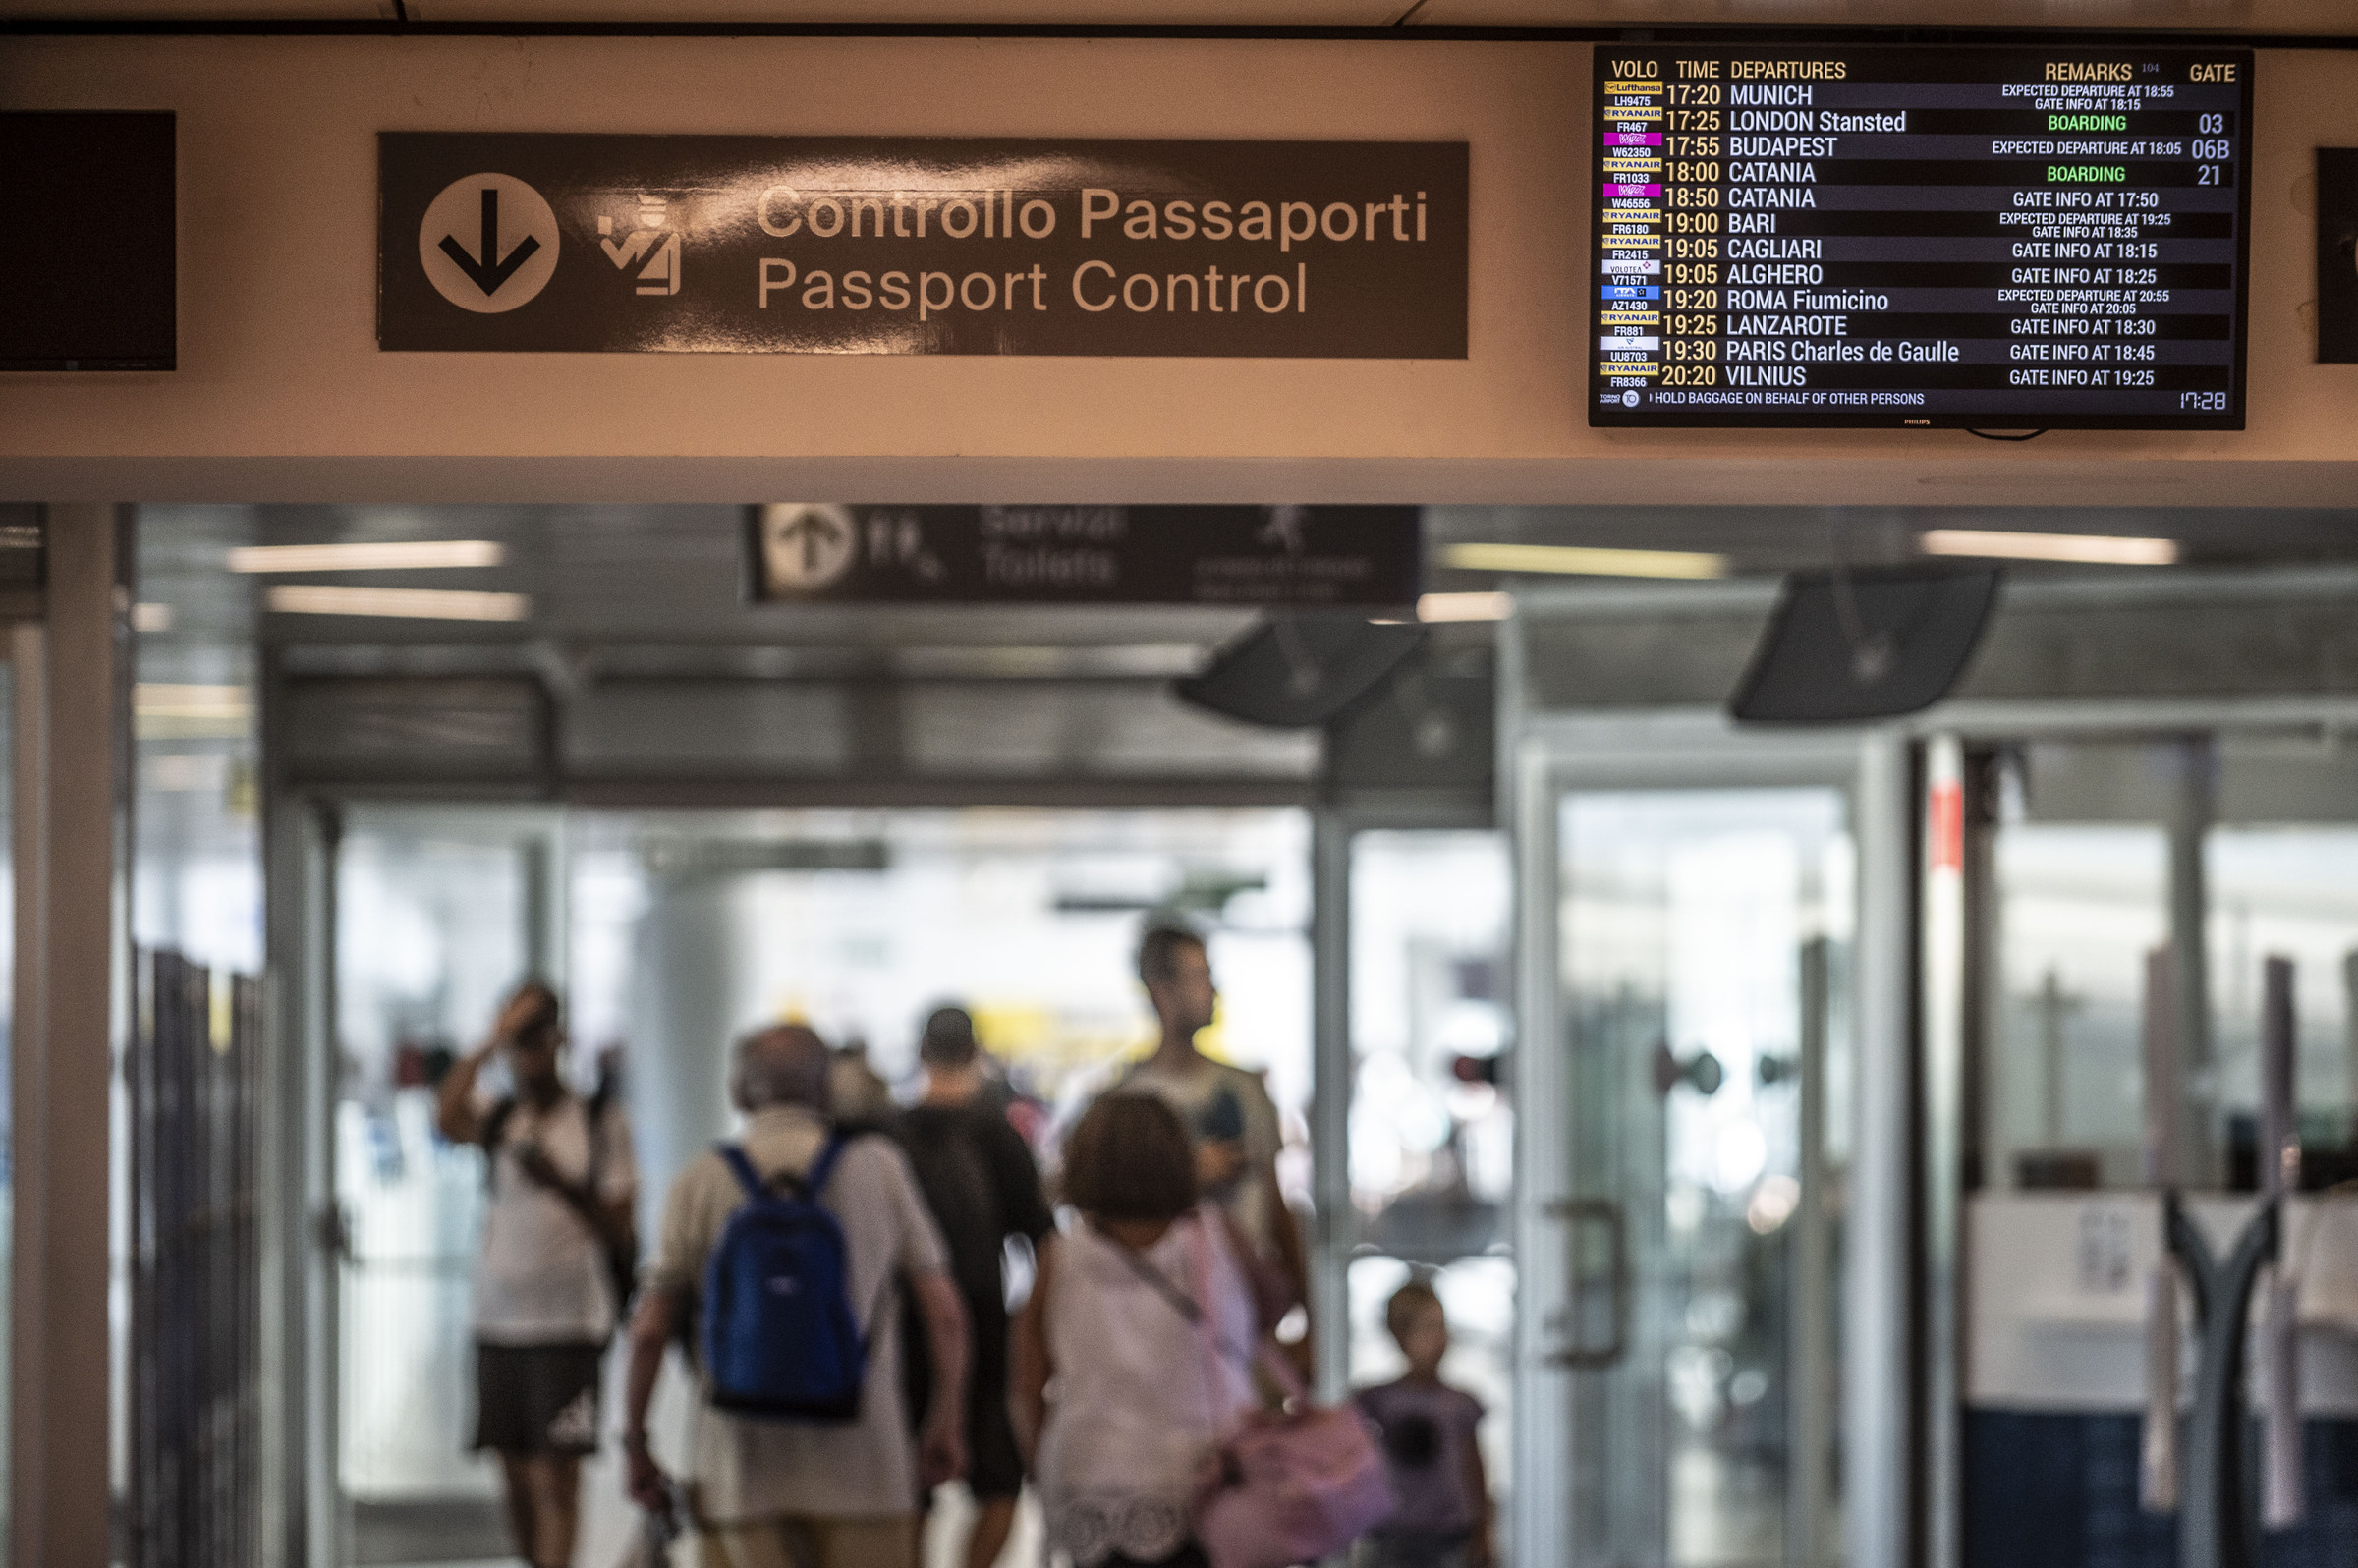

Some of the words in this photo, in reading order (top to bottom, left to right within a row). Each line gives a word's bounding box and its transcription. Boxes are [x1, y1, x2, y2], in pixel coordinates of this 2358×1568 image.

[1611, 61, 1658, 79] VOLO
[1676, 61, 1719, 79] TIME
[1731, 61, 1847, 79] DEPARTURES
[2046, 63, 2133, 81] REMARKS
[2142, 63, 2160, 73] 104
[2189, 64, 2236, 83] GATE
[1617, 84, 1661, 92] Lufthansa
[1666, 84, 1720, 105] 17:20
[1730, 84, 1813, 106] MUNICH
[2002, 84, 2059, 98] EXPECTED
[2061, 84, 2126, 98] DEPARTURE
[2126, 84, 2142, 98] AT
[2144, 84, 2174, 98] 18:55
[1614, 96, 1651, 106] LH9475
[2035, 98, 2064, 110] GATE
[2066, 98, 2093, 110] INFO
[2094, 98, 2108, 110] AT
[2110, 98, 2141, 110] 18:15
[1617, 122, 1648, 132] FR467
[1666, 110, 1720, 131] 17:25
[1730, 110, 1814, 132] LONDON
[1820, 110, 1906, 132] Stansted
[2048, 115, 2127, 132] BOARDING
[2199, 113, 2223, 135] 03
[1612, 147, 1651, 157] W62350
[1666, 136, 1719, 156] 17:55
[1729, 137, 1837, 157] BUDAPEST
[1993, 141, 2053, 155] EXPECTED
[2057, 141, 2128, 155] DEPARTURE
[2130, 141, 2146, 155] AT
[2148, 141, 2181, 155] 18:05
[2191, 140, 2230, 159] 06B
[1613, 173, 1650, 183] FR1033
[1665, 161, 1719, 182] 18:00
[1729, 162, 1817, 183] CATANIA
[2048, 166, 2126, 183] BOARDING
[2198, 165, 2220, 185] 21
[1611, 198, 1651, 208] W46556
[1665, 187, 1719, 207] 18:50
[1728, 188, 1816, 208] CATANIA
[2013, 193, 2052, 208] GATE
[2055, 193, 2092, 208] INFO
[2095, 193, 2114, 208] AT
[2117, 193, 2159, 208] 17:50
[757, 185, 1057, 239] Controllo
[1081, 188, 1427, 252] Passaporti
[1665, 212, 1718, 233] 19:00
[1728, 213, 1776, 234] BARI
[1999, 212, 2055, 226] EXPECTED
[2058, 212, 2122, 226] DEPARTURE
[2124, 212, 2140, 226] AT
[2142, 212, 2171, 226] 19:25
[1612, 224, 1649, 234] FR6180
[2032, 226, 2061, 239] GATE
[2063, 226, 2089, 239] INFO
[2091, 226, 2106, 239] AT
[2108, 226, 2138, 239] 18:35
[1612, 250, 1649, 259] FR2415
[1664, 238, 1718, 258] 19:05
[1727, 239, 1822, 259] CAGLIARI
[2012, 243, 2051, 259] GATE
[2055, 243, 2091, 259] INFO
[2094, 243, 2112, 259] AT
[2116, 243, 2158, 259] 18:15
[1611, 275, 1647, 285] V71571
[1664, 263, 1717, 284] 19:05
[1727, 264, 1824, 285] ALGHERO
[2012, 268, 2050, 285] GATE
[2054, 268, 2090, 285] INFO
[2093, 268, 2112, 285] AT
[2116, 268, 2157, 285] 18:25
[758, 257, 1047, 321] Passport
[1071, 260, 1307, 314] Control
[1998, 289, 2054, 303] EXPECTED
[2057, 289, 2121, 303] DEPARTURE
[2123, 289, 2138, 303] AT
[2140, 289, 2169, 303] 20:55
[1611, 301, 1648, 310] AZ1430
[1664, 289, 1717, 309] 19:20
[1727, 290, 1788, 310] ROMA
[1793, 289, 1888, 310] Fiumicino
[2031, 303, 2059, 314] GATE
[2061, 303, 2087, 314] INFO
[2089, 303, 2105, 314] AT
[2106, 303, 2136, 314] 20:05
[1614, 326, 1644, 336] FR881
[1663, 314, 1717, 335] 19:25
[1726, 315, 1847, 336] LANZAROTE
[2010, 319, 2049, 336] GATE
[2053, 319, 2089, 336] INFO
[2092, 319, 2111, 336] AT
[2114, 319, 2156, 336] 18:30
[1610, 352, 1648, 362] UU8703
[1663, 340, 1716, 361] 19:30
[1726, 341, 1786, 362] PARIS
[1791, 340, 1864, 362] Charles
[1869, 340, 1892, 362] de
[1898, 341, 1960, 362] Gaulle
[2010, 345, 2049, 361] GATE
[2053, 345, 2089, 361] INFO
[2091, 345, 2110, 361] AT
[2114, 345, 2155, 361] 18:45
[1611, 377, 1647, 387] FR8366
[1661, 365, 1716, 386] 20:20
[1725, 365, 1807, 387] VILNIUS
[2010, 370, 2049, 386] GATE
[2052, 370, 2087, 386] INFO
[2091, 370, 2110, 386] AT
[2113, 370, 2154, 386] 19:25
[1655, 392, 1686, 404] HOLD
[1688, 392, 1743, 404] BAGGAGE
[1745, 392, 1762, 404] ON
[1765, 392, 1810, 404] BEHALF
[1812, 393, 1827, 405] OF
[1829, 393, 1868, 405] OTHER
[1871, 393, 1925, 405] PERSONS
[2180, 392, 2226, 411] 17:28
